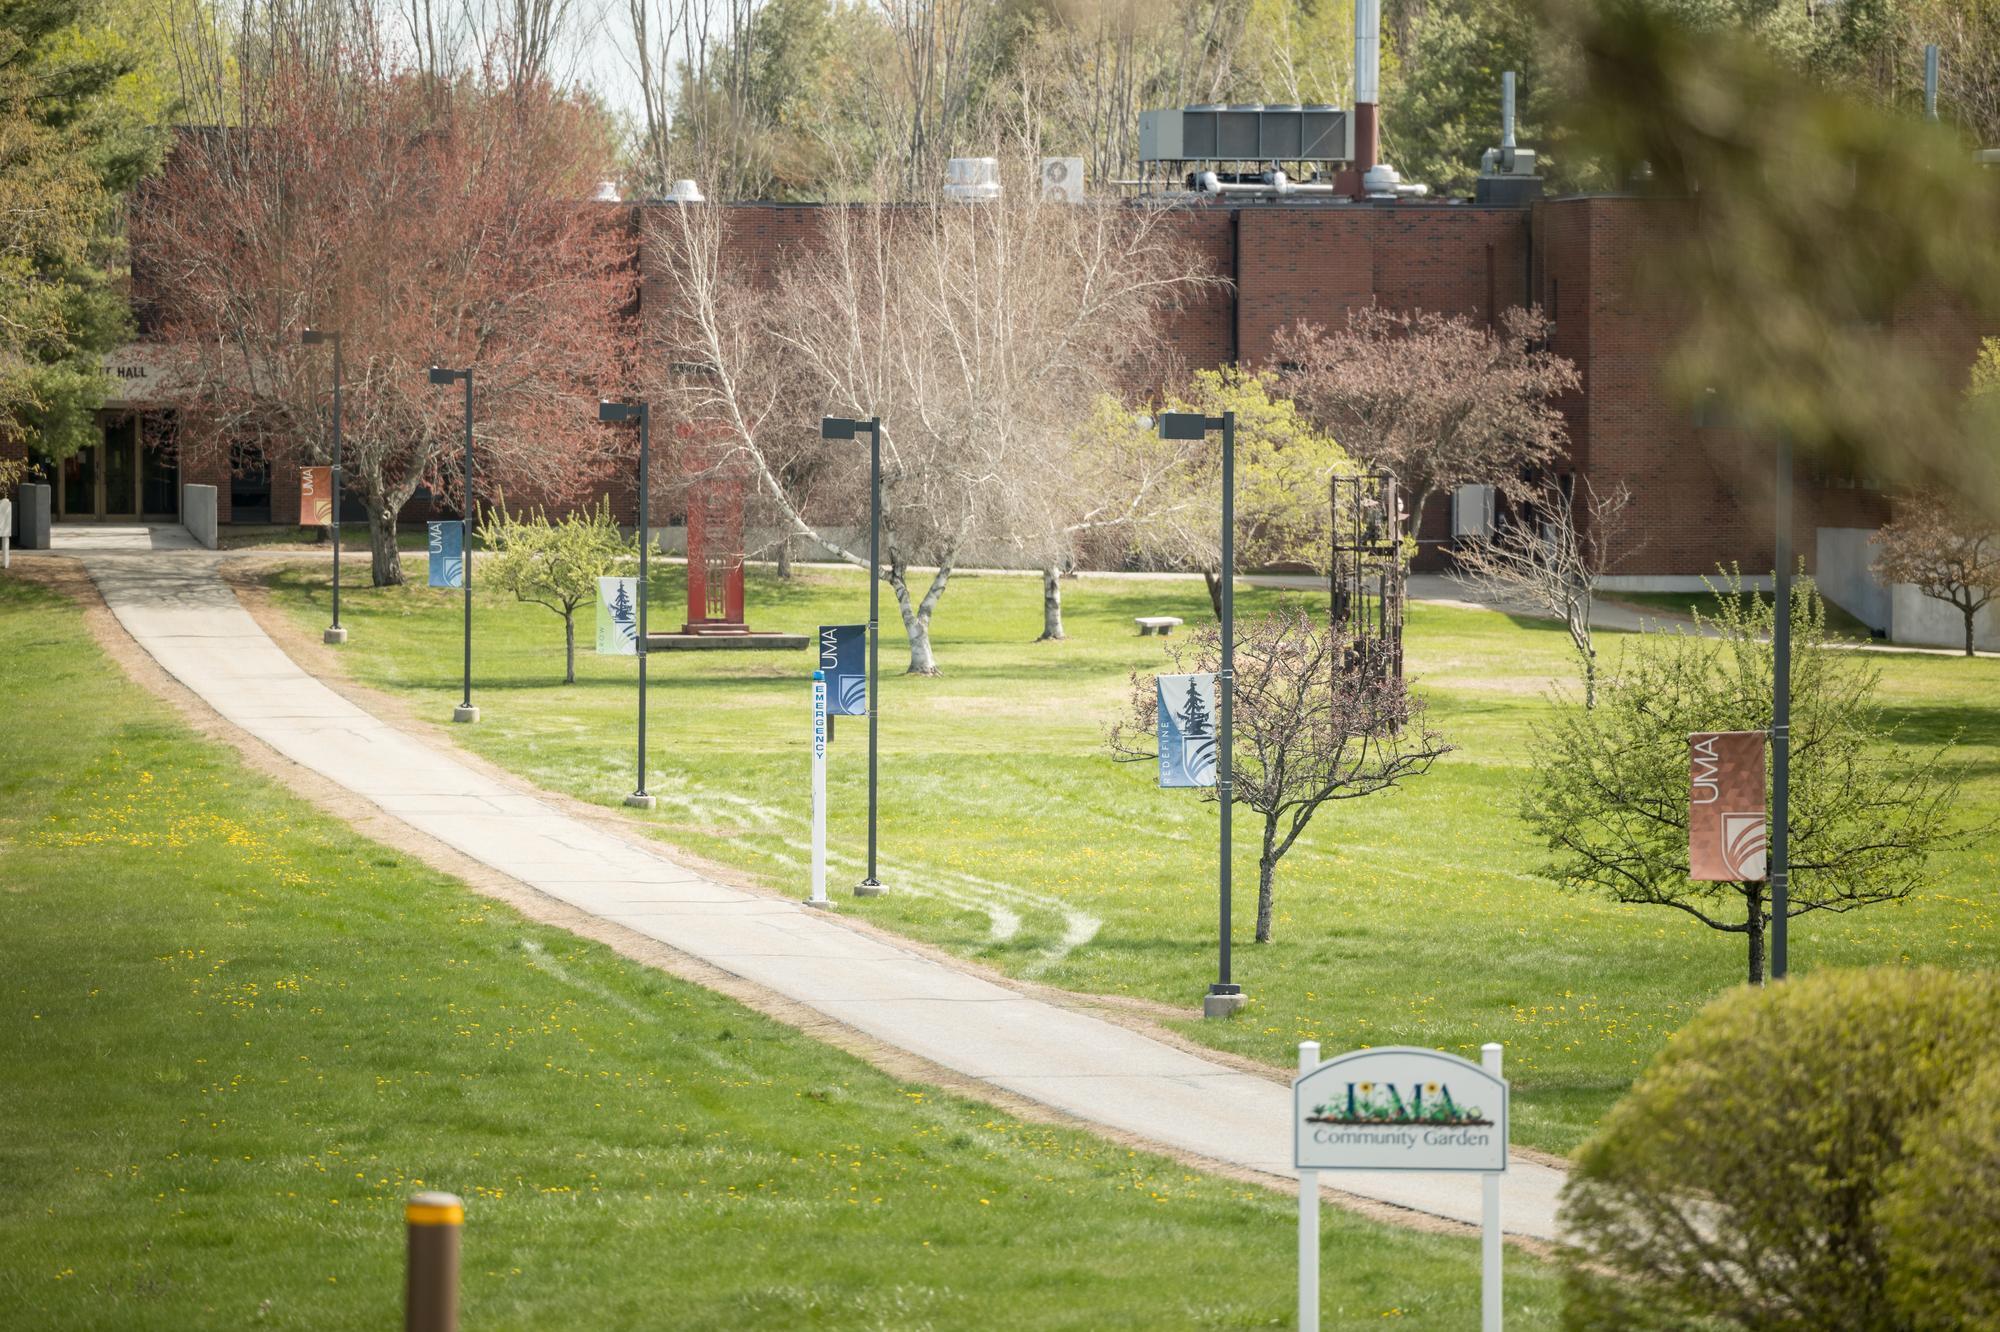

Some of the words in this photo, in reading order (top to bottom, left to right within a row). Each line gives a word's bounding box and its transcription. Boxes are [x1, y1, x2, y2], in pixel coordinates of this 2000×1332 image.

[117, 366, 149, 378] HALL
[302, 468, 314, 496] UMA
[430, 523, 443, 554] UMA
[821, 628, 838, 669] UMA
[815, 685, 825, 760] EMERGENCY
[1161, 722, 1170, 784] REDEFINE
[1693, 736, 1719, 804] UMA
[1313, 1129, 1417, 1149] Community
[1424, 1129, 1489, 1146] Garden
